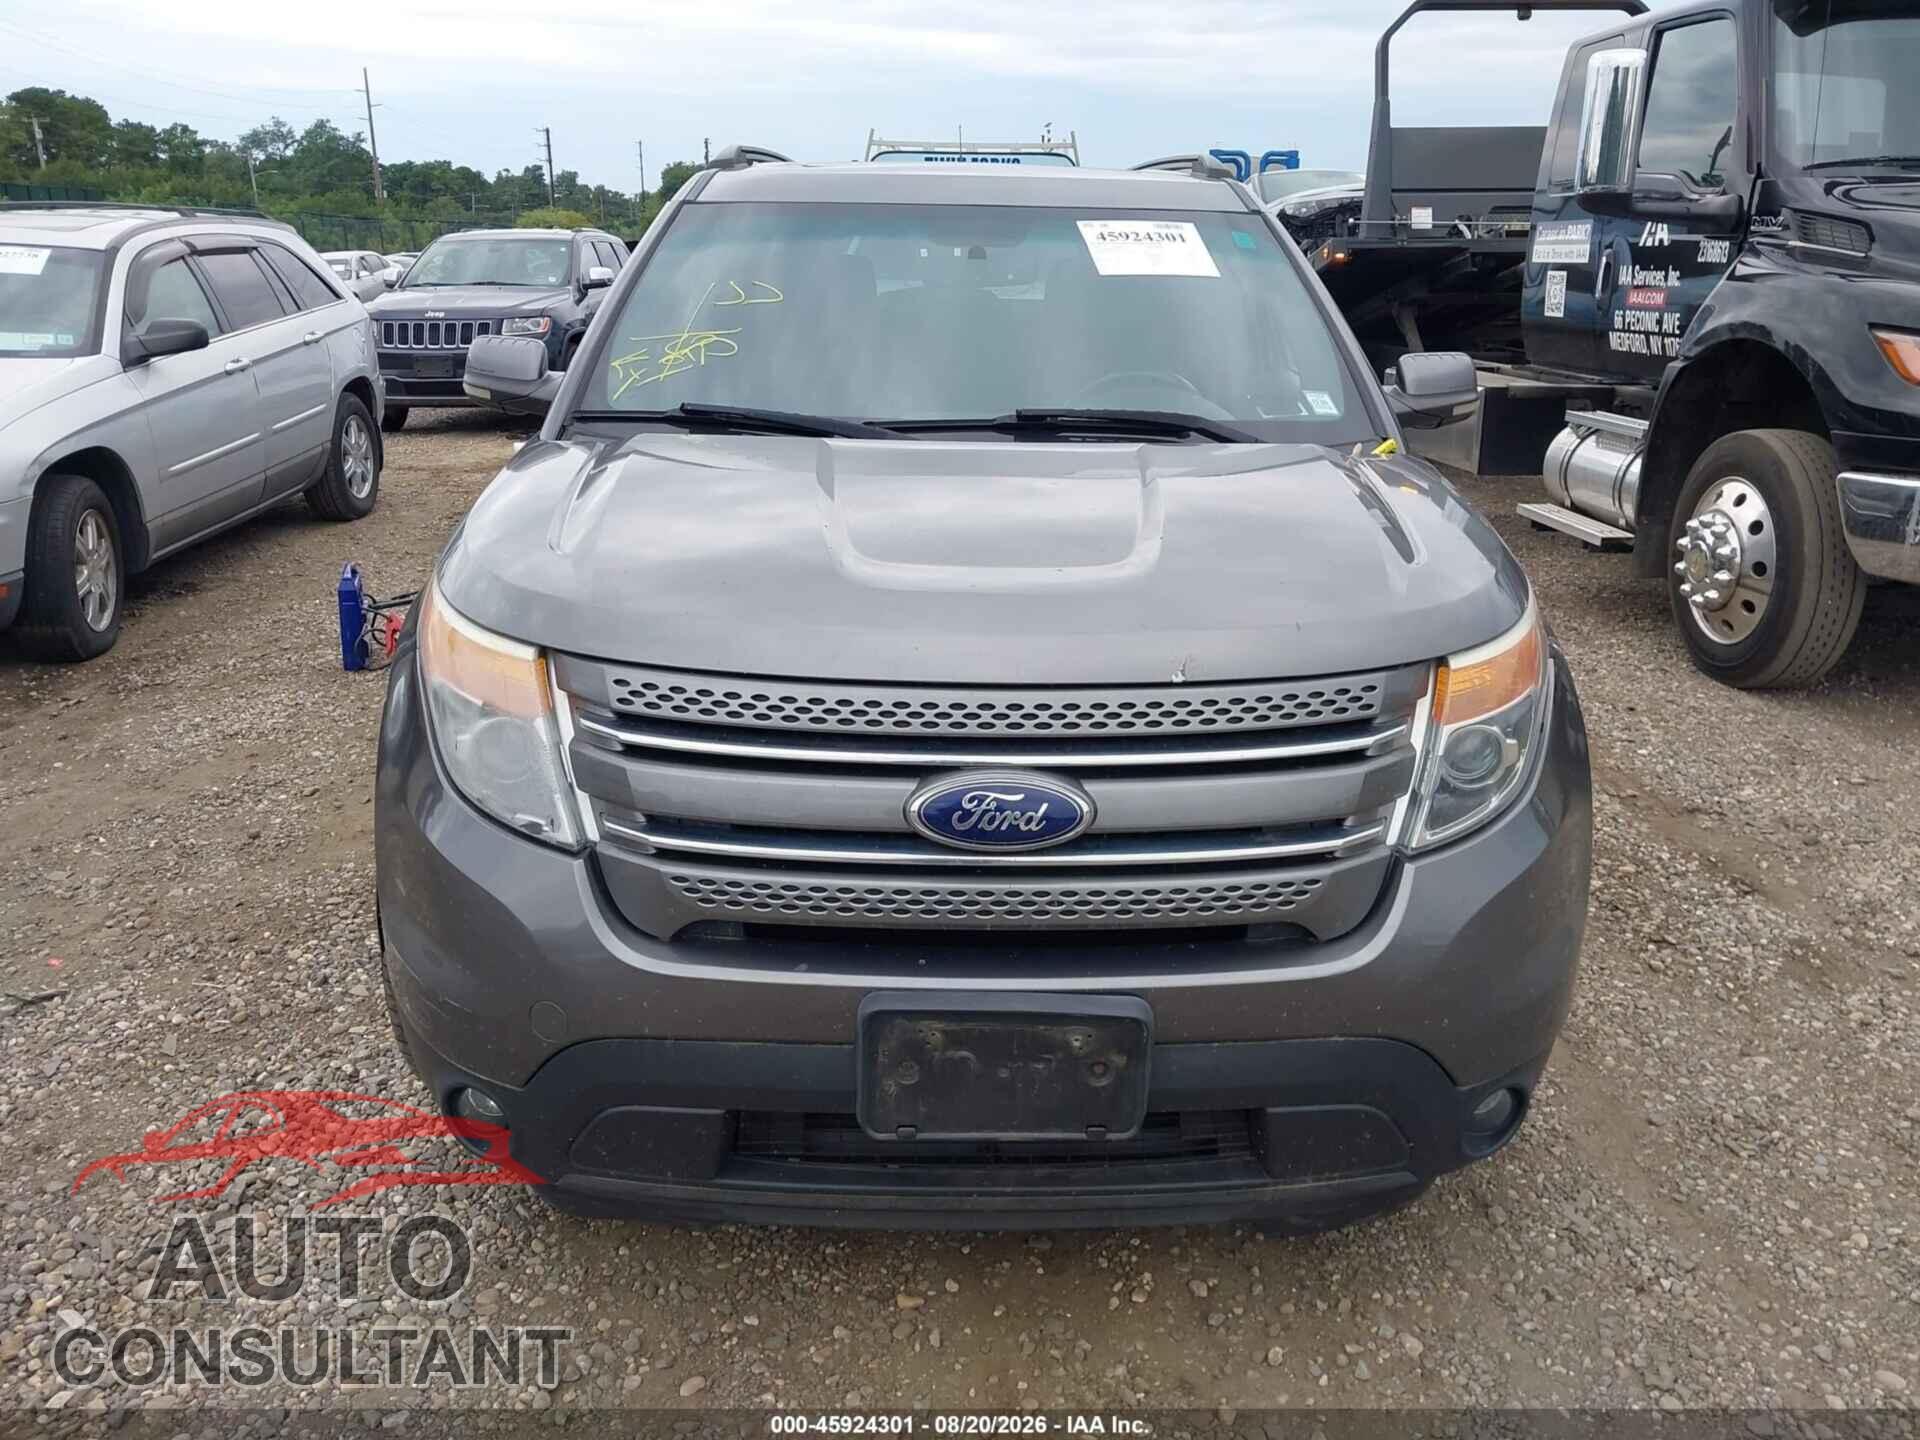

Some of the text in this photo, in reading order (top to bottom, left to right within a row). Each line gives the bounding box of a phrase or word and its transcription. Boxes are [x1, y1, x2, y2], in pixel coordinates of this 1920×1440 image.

[1097, 231, 1186, 243] 45924301
[1618, 265, 1681, 288] IAA Services, Inc.
[424, 310, 445, 318] Jeep
[1614, 309, 1681, 335] 66 PECONIC AVE
[1609, 331, 1650, 356] MEDFORD,
[1650, 334, 1662, 355] NY
[951, 790, 1049, 832] Ford
